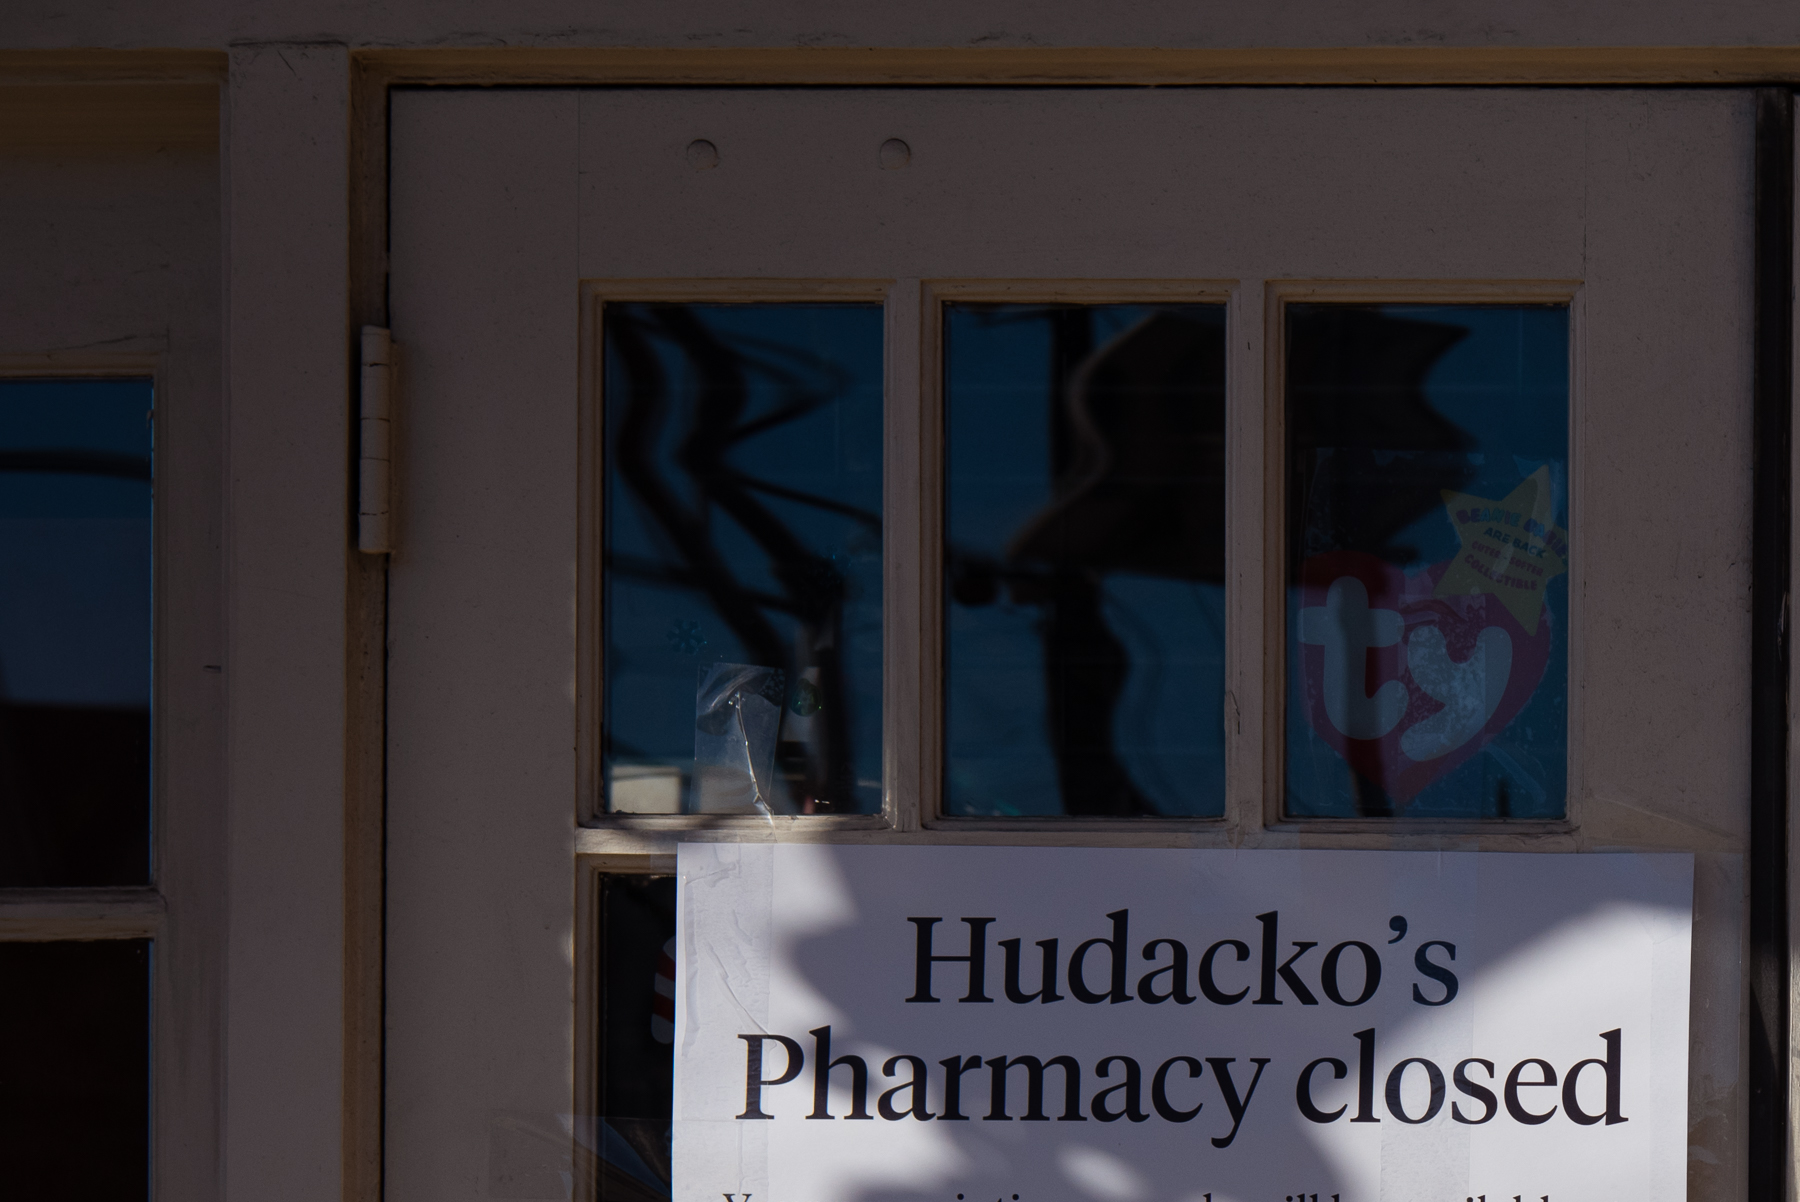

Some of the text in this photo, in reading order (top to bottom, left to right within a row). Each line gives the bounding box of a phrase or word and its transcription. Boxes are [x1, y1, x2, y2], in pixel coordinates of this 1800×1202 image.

[1456, 507, 1521, 527] BEANIE
[1483, 527, 1546, 558] ARE BACK
[1509, 556, 1543, 576] SOFTER
[905, 909, 1459, 1007] Hudacko's
[735, 1025, 1629, 1148] Pharmacy closed
